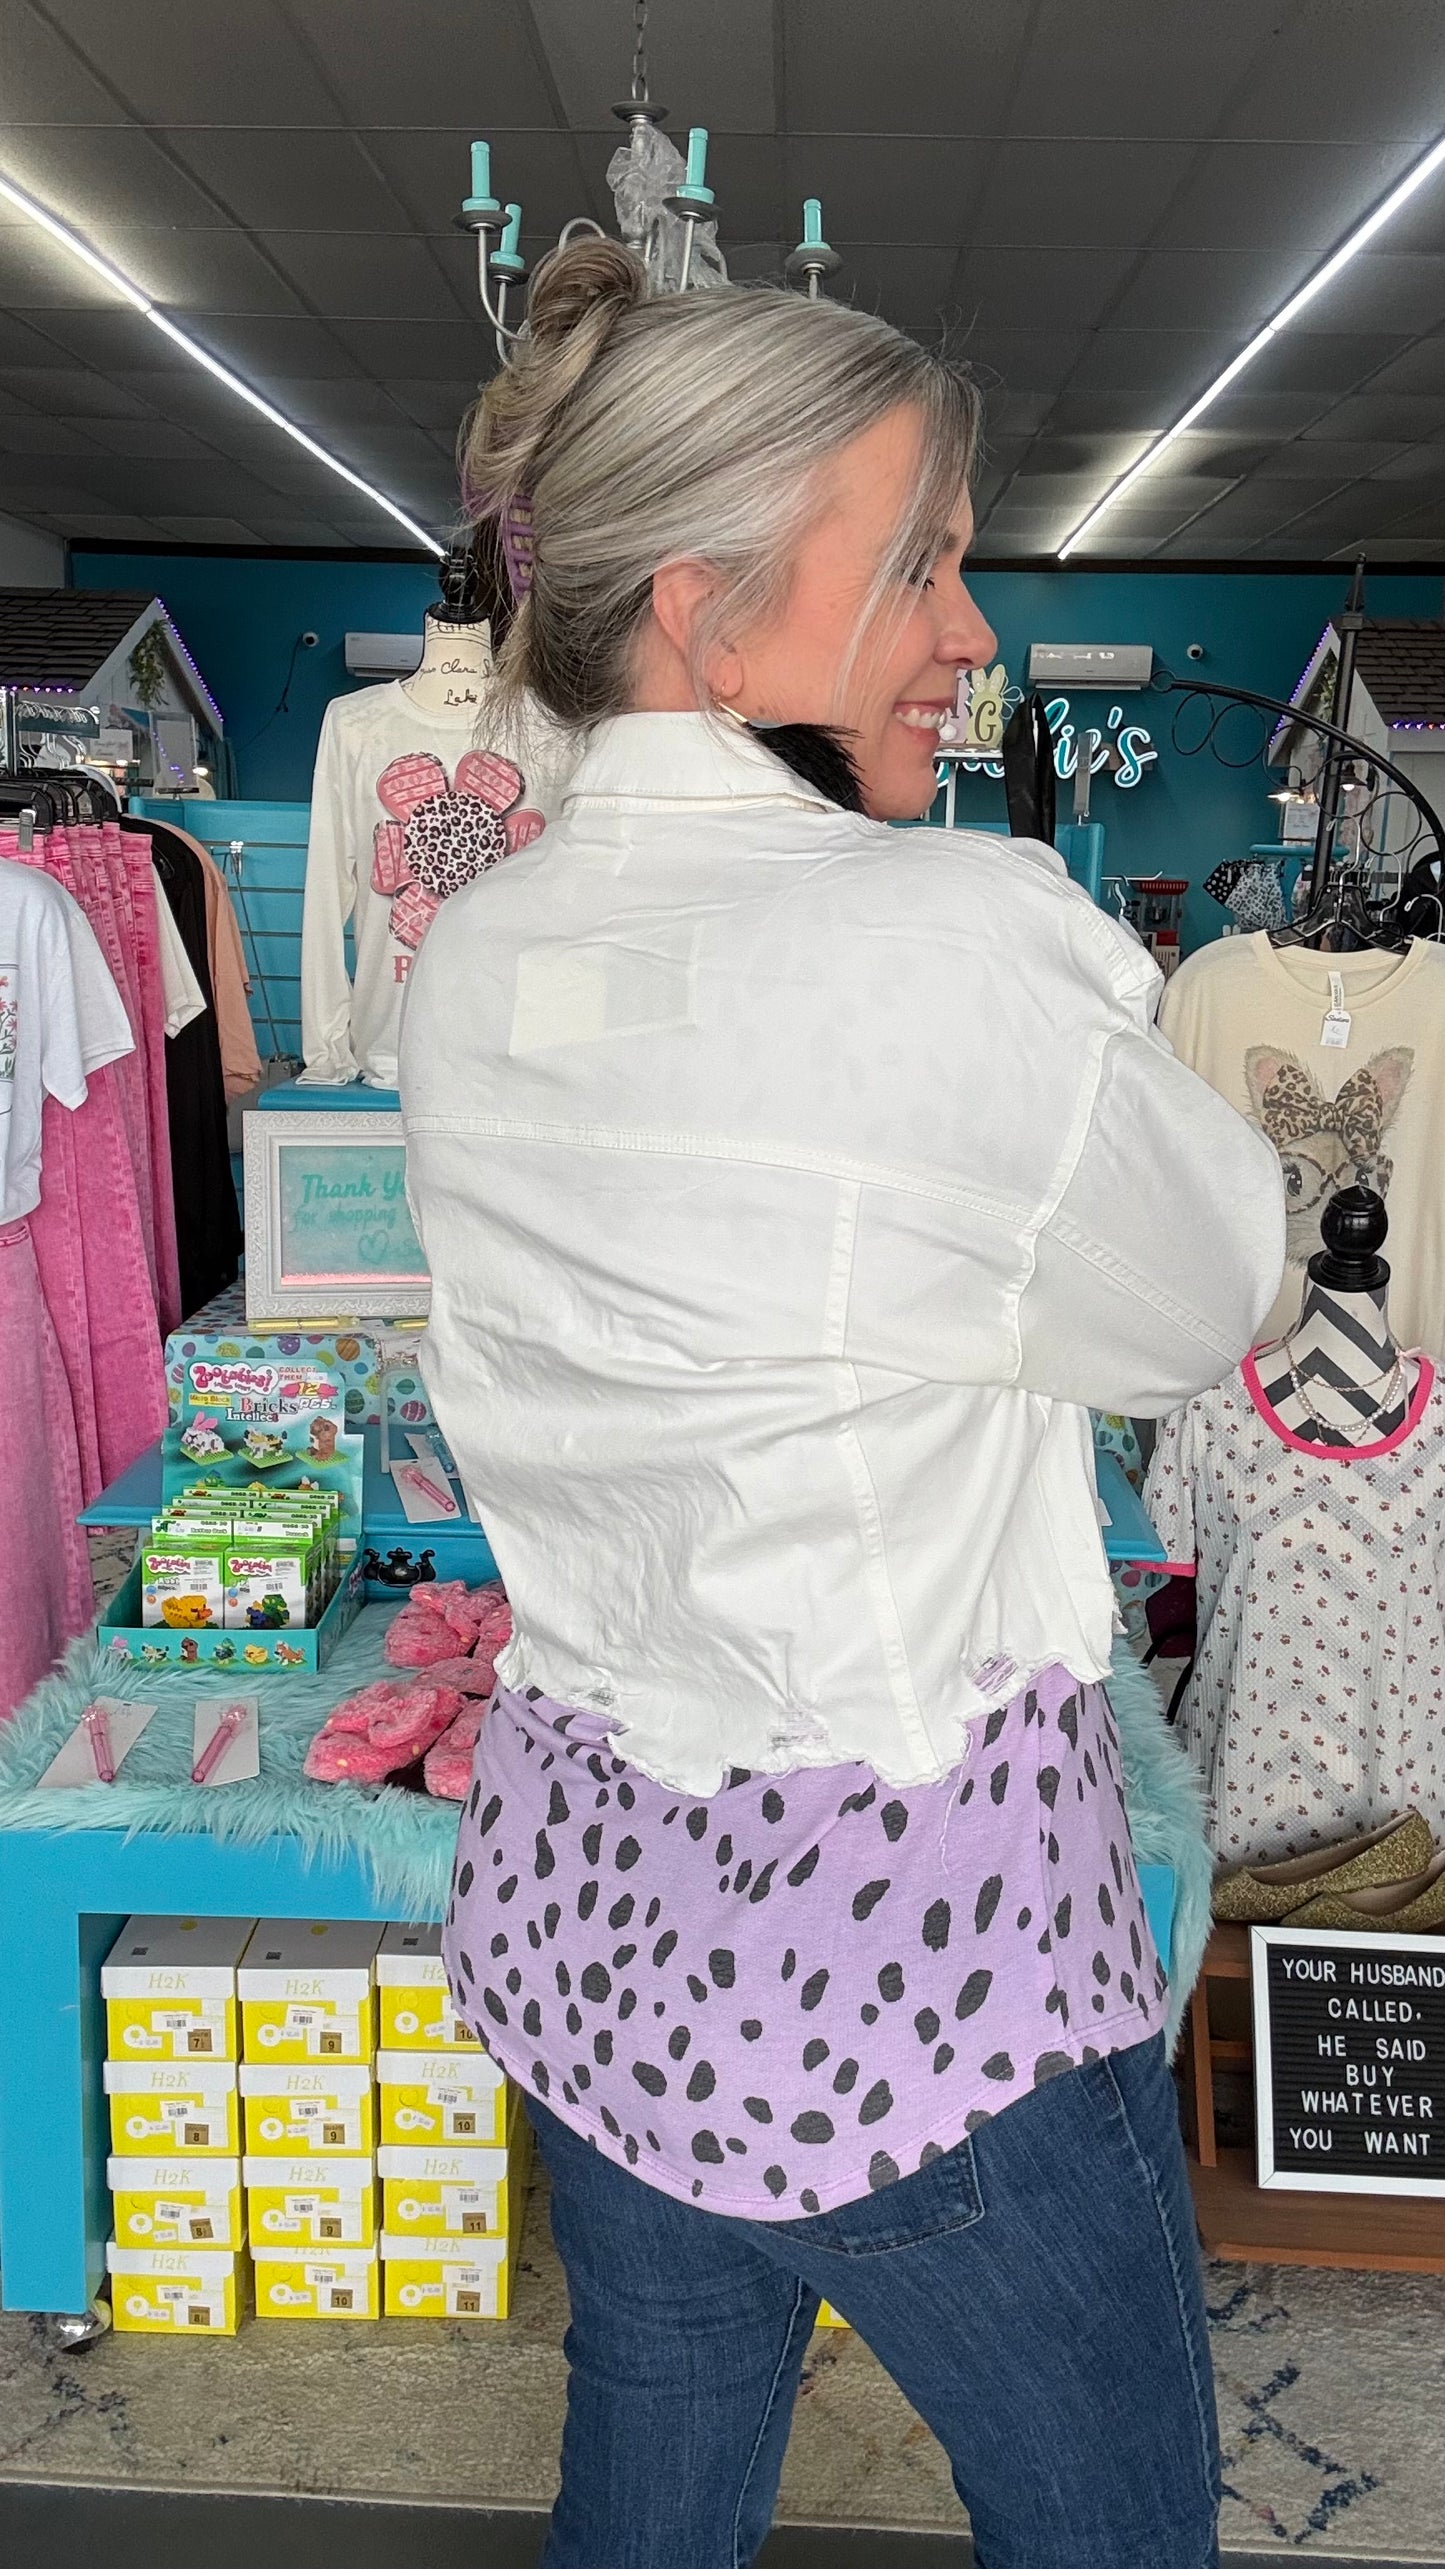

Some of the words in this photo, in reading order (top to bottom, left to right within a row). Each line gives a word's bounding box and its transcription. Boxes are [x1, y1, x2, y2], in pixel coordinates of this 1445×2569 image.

[443, 688, 478, 706] Lake
[301, 1172, 377, 1208] Thank
[383, 1170, 406, 1201] Y
[328, 1200, 398, 1231] shopping
[298, 1382, 320, 1397] 12
[240, 1397, 298, 1414] Bricks
[422, 1964, 445, 1980] H2
[1281, 1958, 1337, 1983] YOUR
[1350, 1961, 1445, 1988] HUSBAND
[148, 1973, 189, 1989] H2K
[284, 1978, 326, 1996] H2K
[460, 2029, 473, 2039] 10
[328, 2041, 335, 2050] 9
[1317, 2034, 1347, 2057] HE
[1376, 2037, 1426, 2061] SAID
[421, 2062, 461, 2078] H2K
[1346, 2064, 1395, 2087] BUY
[151, 2072, 190, 2087] H2K
[286, 2075, 326, 2090] H2K
[1301, 2090, 1433, 2118] WHATEVER
[458, 2121, 471, 2131] 10
[193, 2135, 200, 2145] 8
[330, 2131, 337, 2141] 9
[1289, 2127, 1333, 2151] YOU
[1364, 2130, 1431, 2156] WANT
[288, 2166, 329, 2182] H2K
[423, 2158, 464, 2175] H2K
[153, 2168, 193, 2186] H2K
[470, 2222, 481, 2231] 11
[335, 2296, 347, 2306] 10
[464, 2301, 475, 2311] 11
